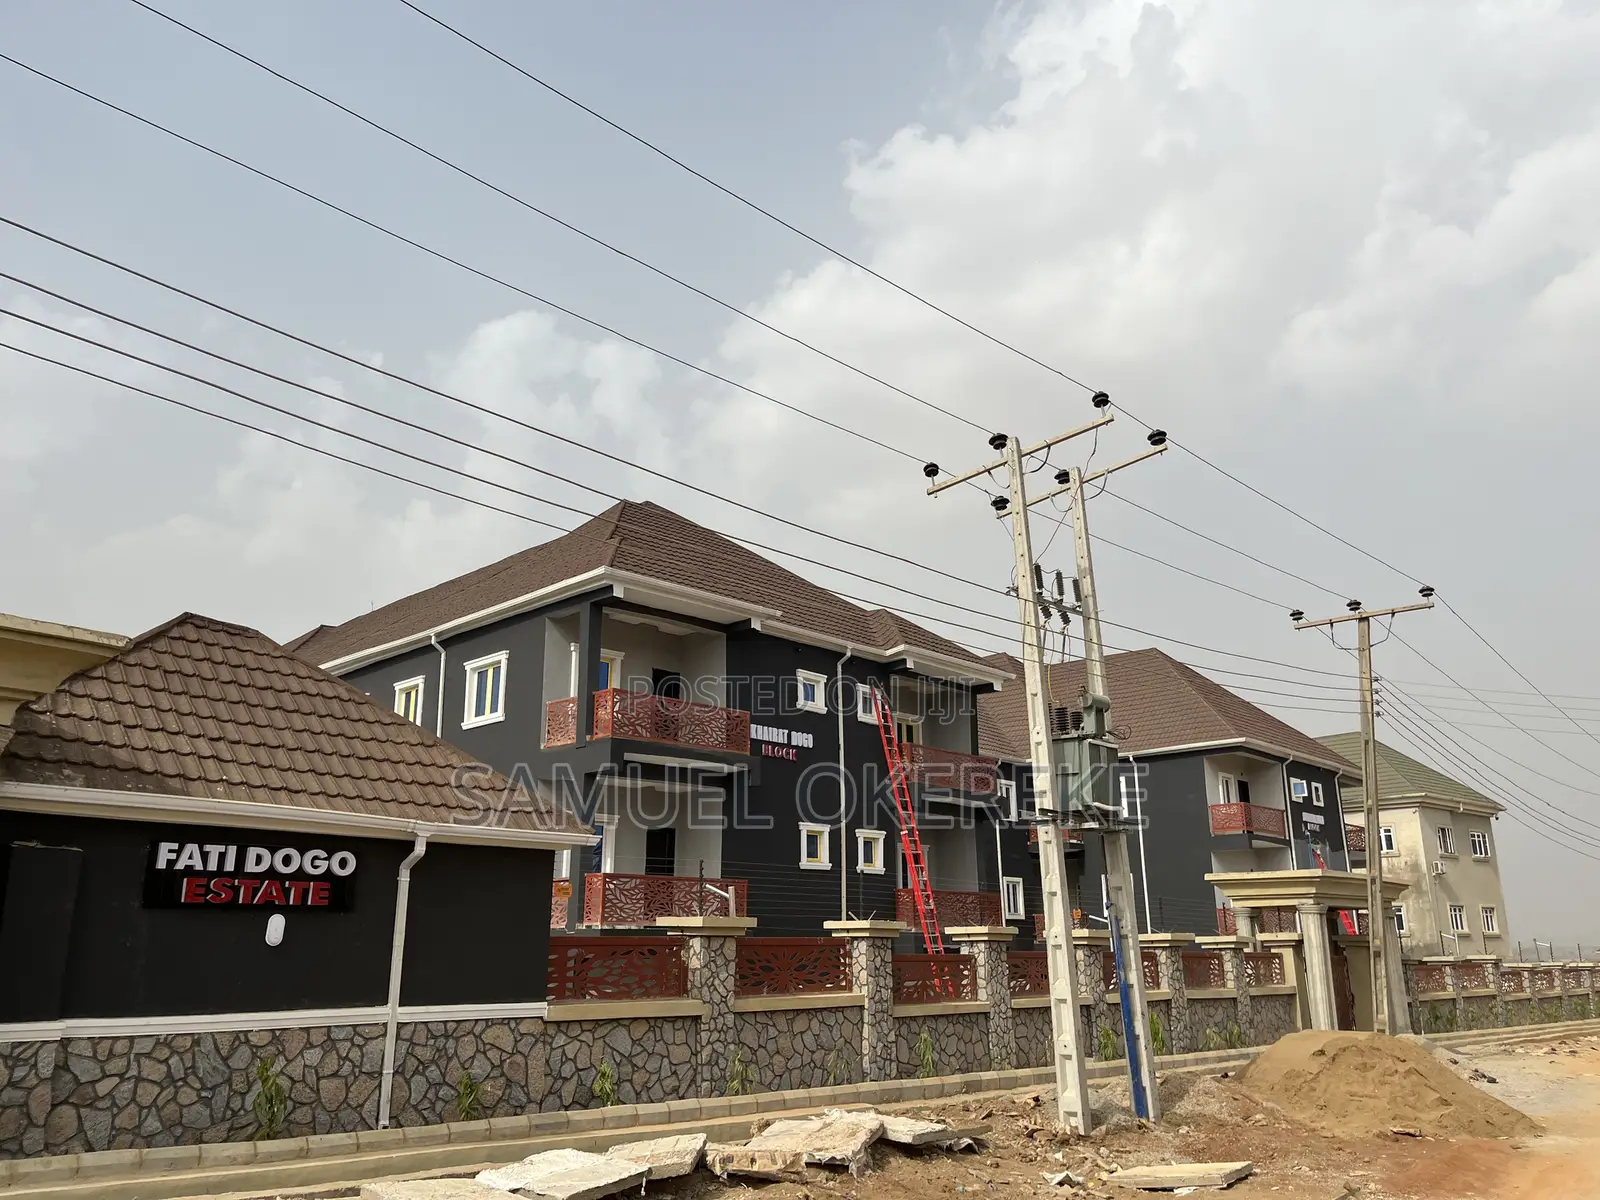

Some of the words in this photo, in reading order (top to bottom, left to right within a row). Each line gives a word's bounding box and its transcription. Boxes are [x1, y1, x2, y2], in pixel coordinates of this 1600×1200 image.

[790, 731, 814, 748] DOGO
[762, 743, 798, 761] BLOCK
[155, 842, 237, 872] FATI
[244, 846, 357, 877] DOGO
[181, 877, 331, 906] ESTATE
